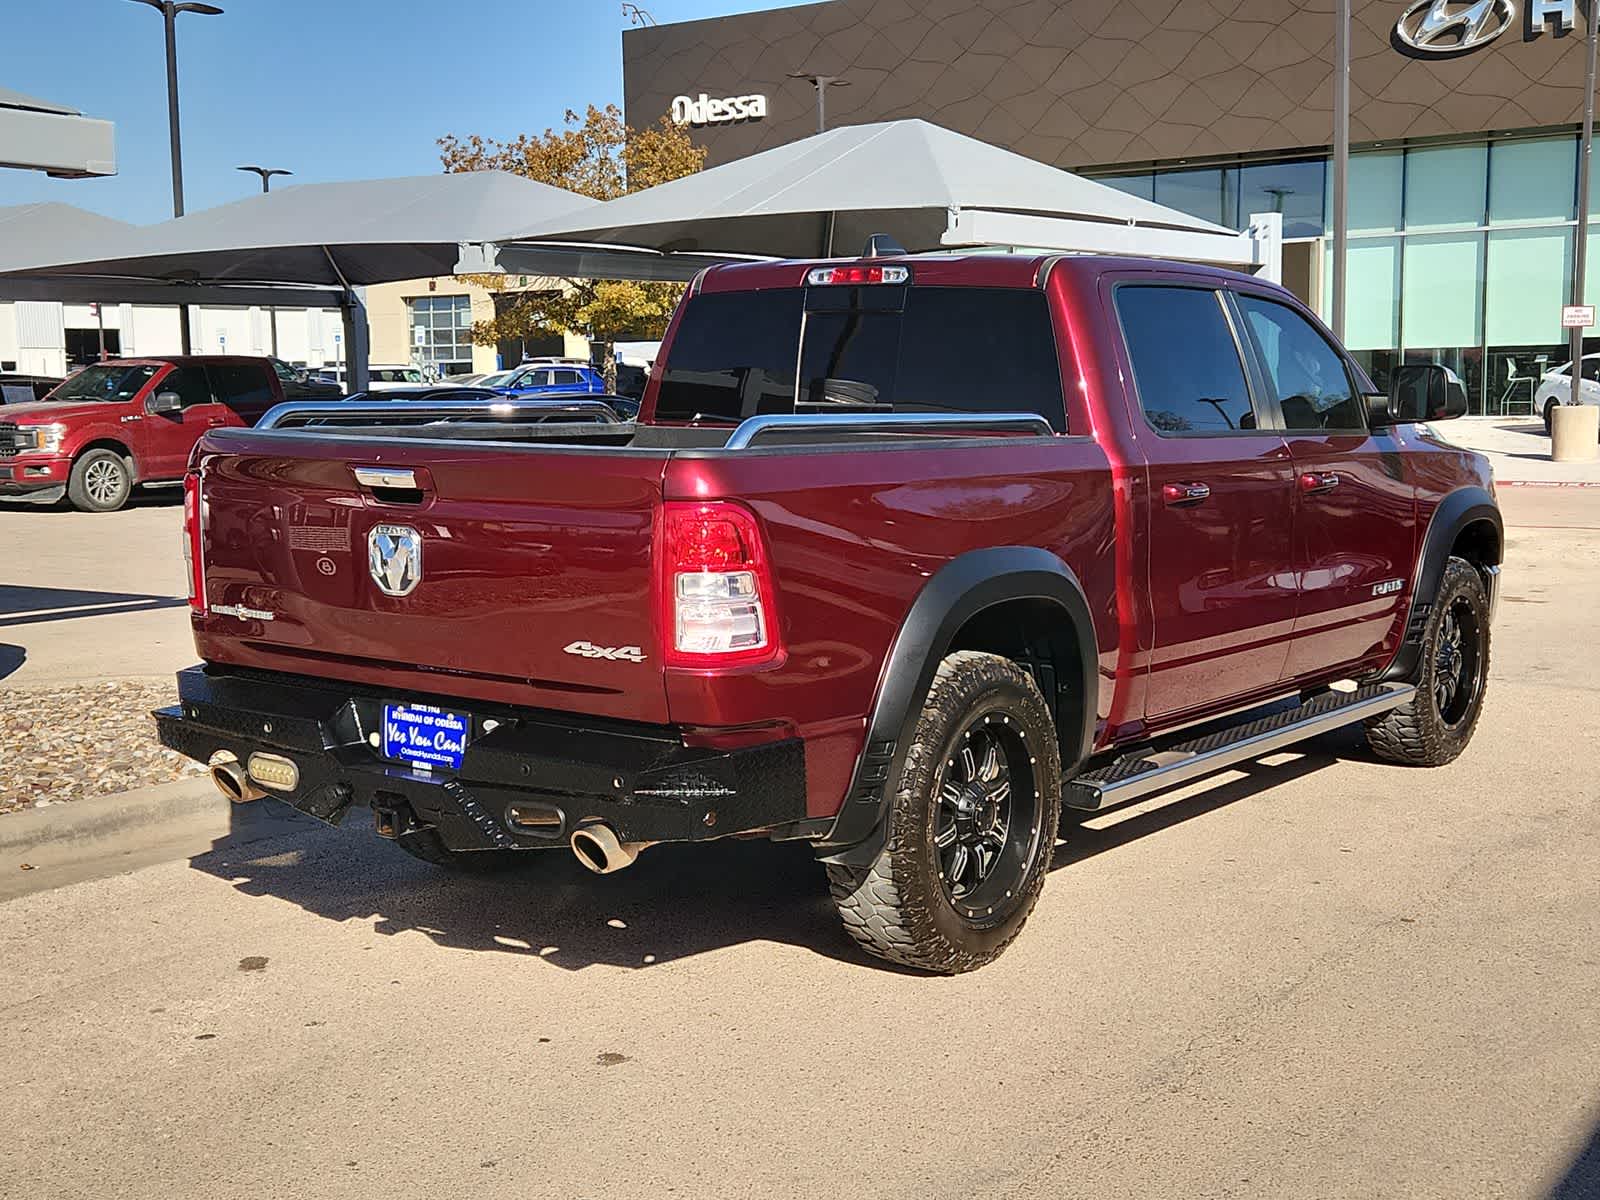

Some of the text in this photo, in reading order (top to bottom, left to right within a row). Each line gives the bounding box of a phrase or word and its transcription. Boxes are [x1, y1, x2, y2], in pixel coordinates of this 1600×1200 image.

[671, 93, 767, 125] Odessa
[562, 640, 648, 663] 4x4
[424, 716, 434, 725] OF
[435, 718, 463, 730] ODESSA
[388, 722, 466, 754] Yes You Can!
